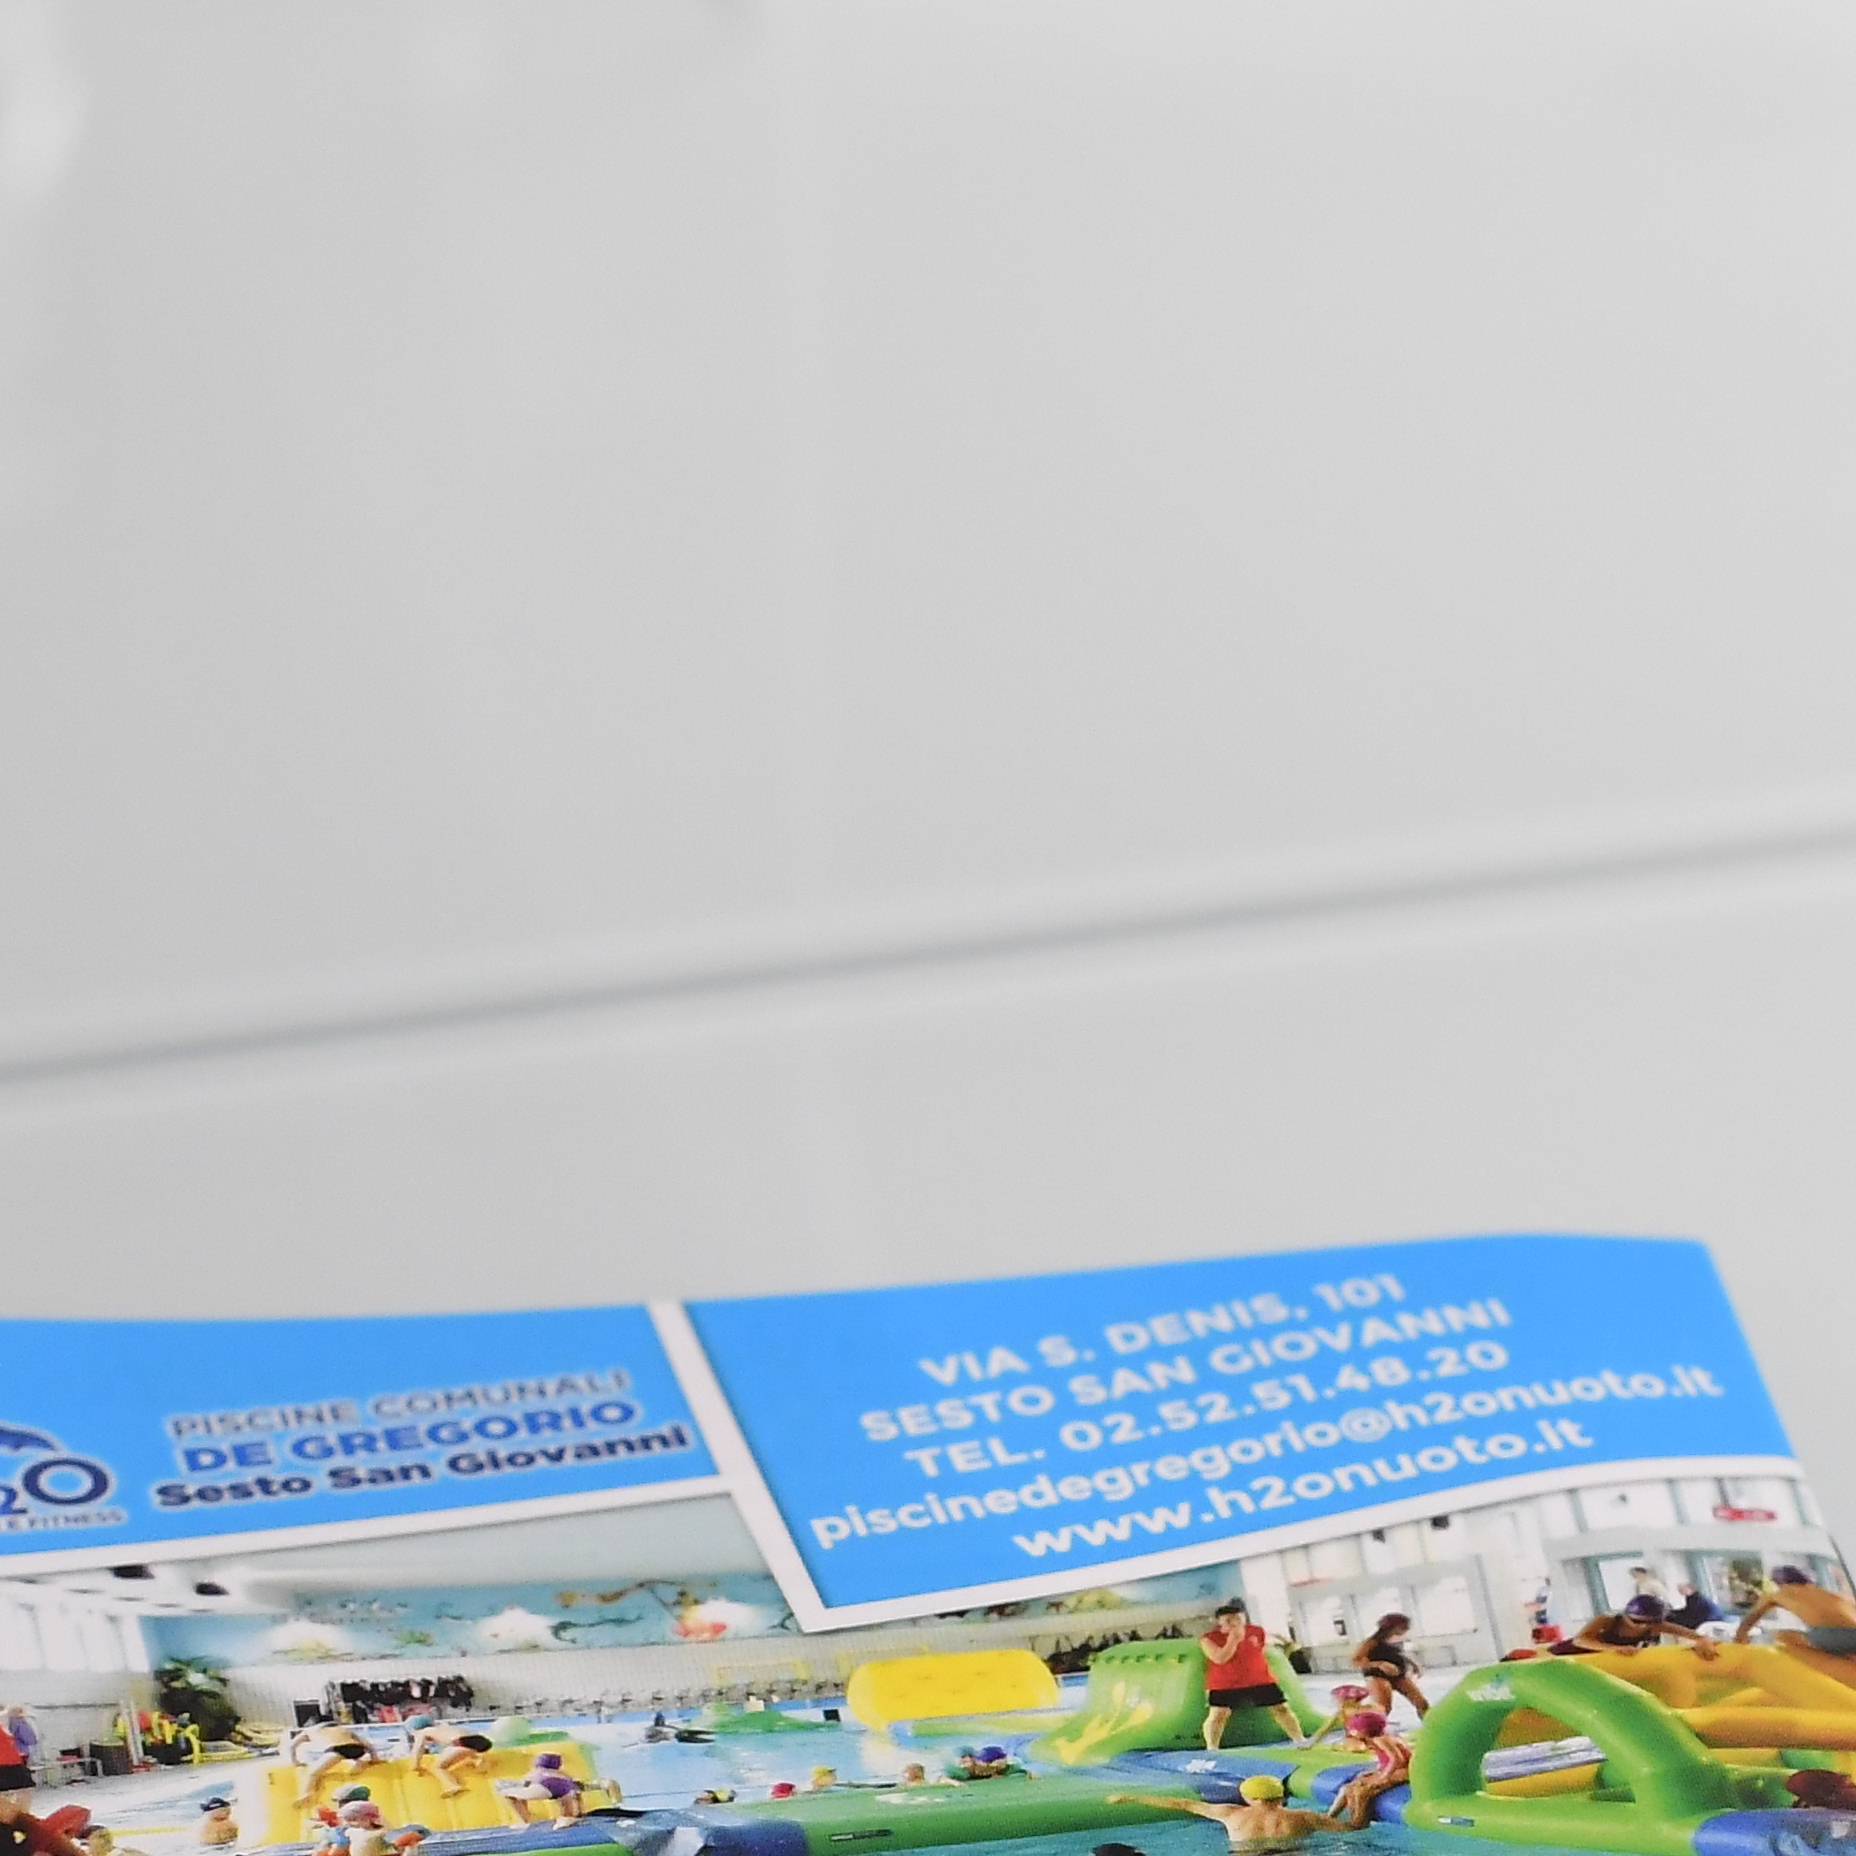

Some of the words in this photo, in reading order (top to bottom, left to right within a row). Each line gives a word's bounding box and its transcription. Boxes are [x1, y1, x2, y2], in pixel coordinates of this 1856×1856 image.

[859, 1385, 1055, 1441] SESTO
[1068, 1355, 1197, 1406] SAN
[1209, 1298, 1512, 1376] GIOVANNI
[918, 1345, 1030, 1386] VIA
[1037, 1335, 1096, 1368] S.
[1313, 1274, 1406, 1311] 101
[156, 1476, 312, 1507] Sesto
[327, 1464, 432, 1489] San
[447, 1424, 688, 1474] Giovanni
[172, 1399, 357, 1438] PISCINE
[374, 1370, 626, 1417] COMUNALI
[184, 1441, 273, 1473] DE
[292, 1401, 635, 1460] GREGORIO
[809, 1363, 1725, 1550] piscinedegregorio@h2onuoto.it
[903, 1437, 1046, 1478] TEL.
[1058, 1339, 1510, 1452] 02.52.51.48.20
[1011, 1418, 1594, 1557] www.h2onuoto.it
